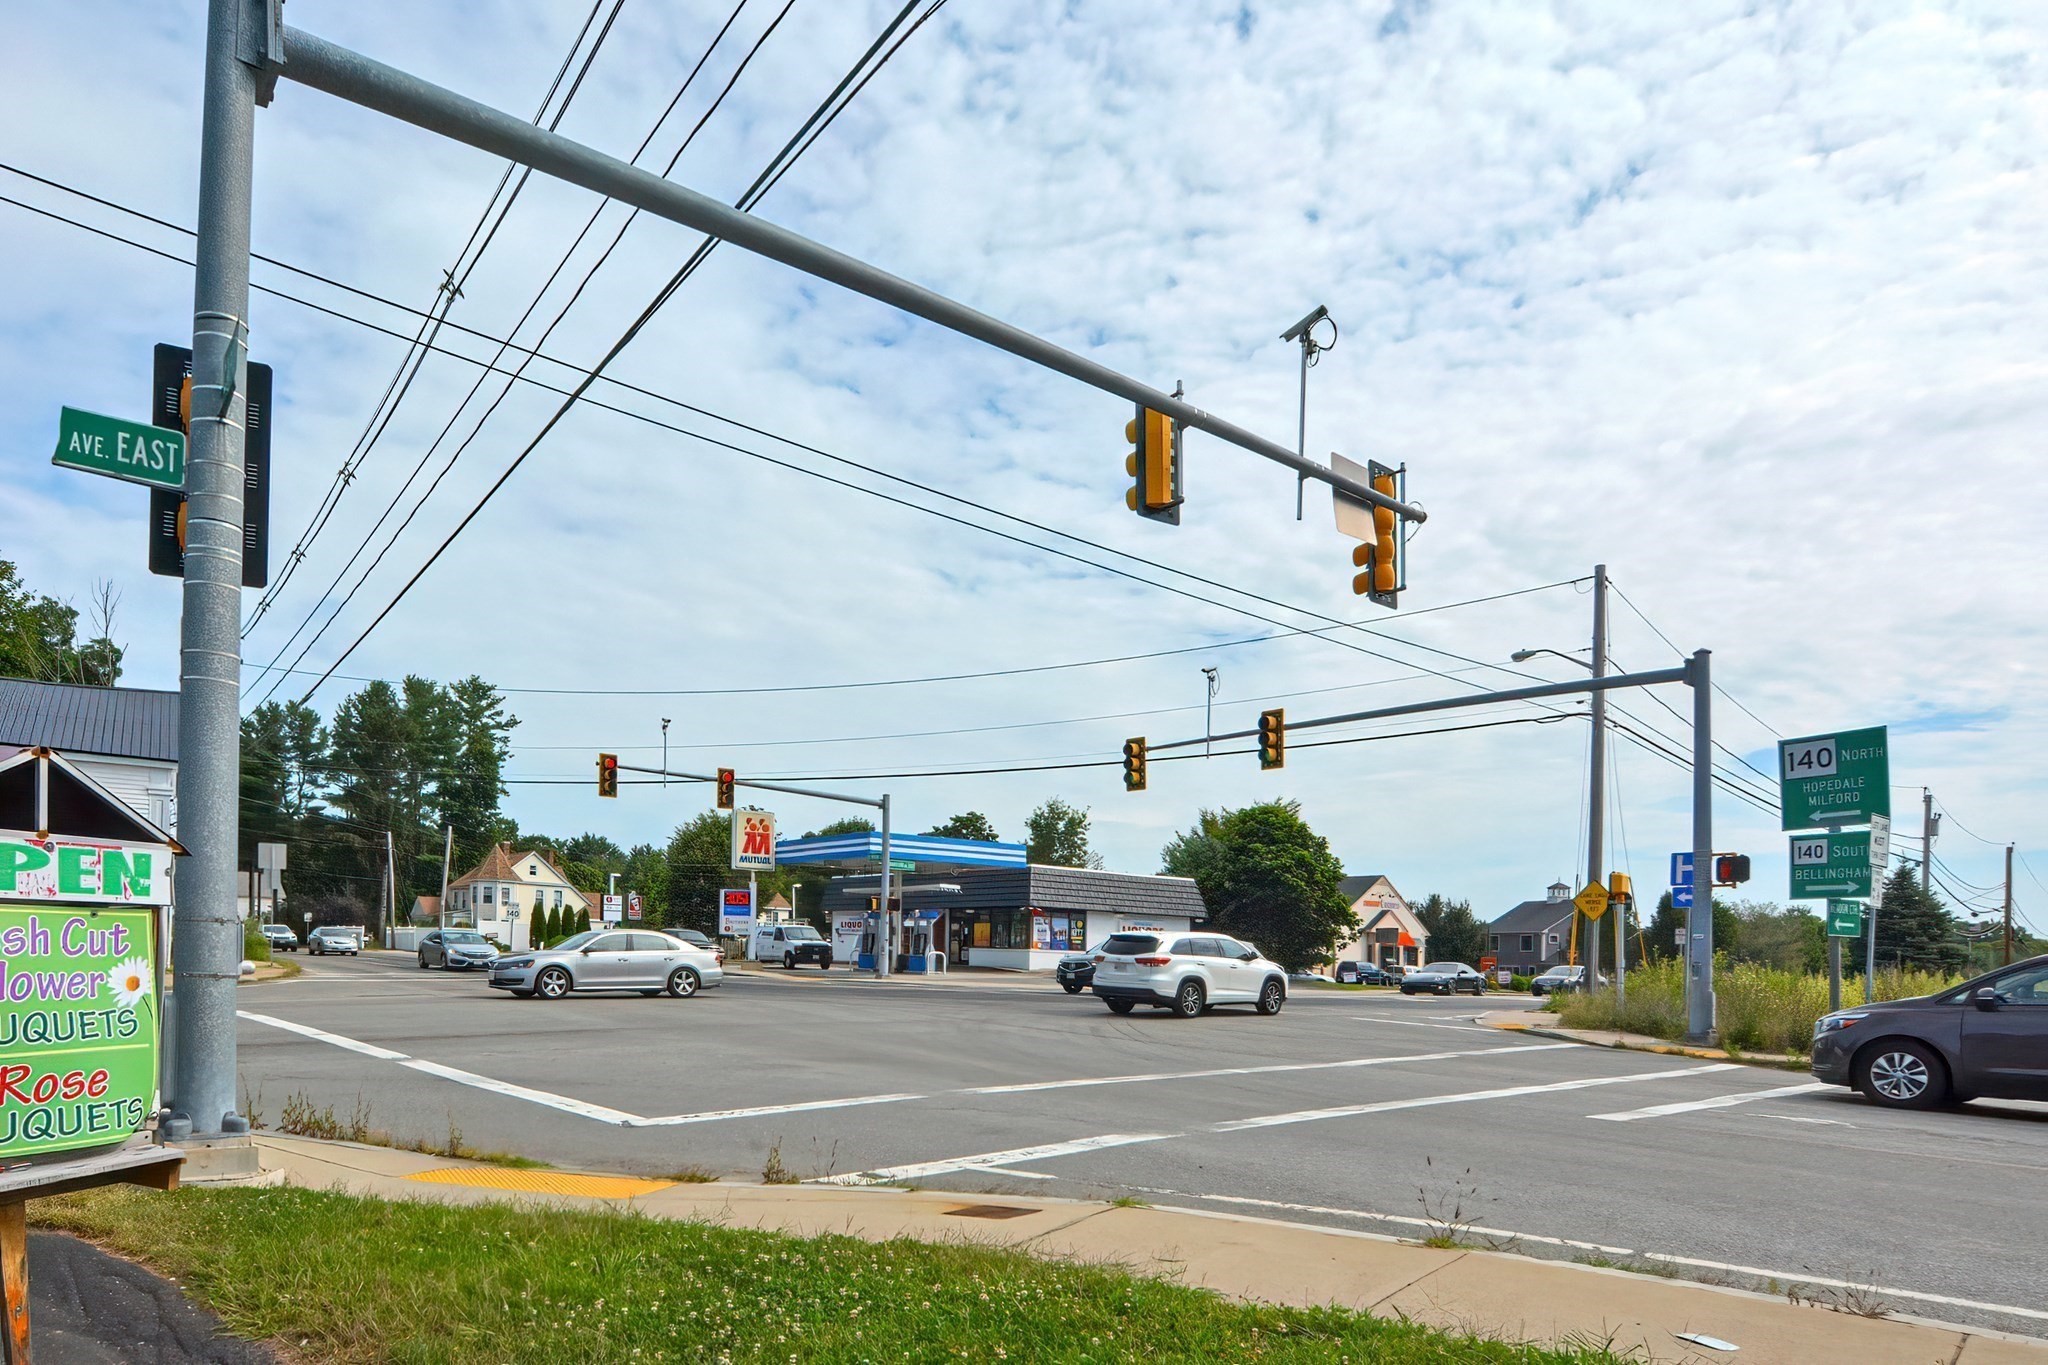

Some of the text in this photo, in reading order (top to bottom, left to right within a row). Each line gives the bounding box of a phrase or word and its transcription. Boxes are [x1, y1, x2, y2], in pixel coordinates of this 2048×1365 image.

[69, 431, 179, 473] AVE. EAST
[1787, 747, 1884, 772] 140 NORTH
[1803, 776, 1865, 793] HOPEDALE
[1808, 791, 1860, 806] MILFORD
[739, 855, 771, 864] MUTUAL
[1798, 845, 1823, 859] 140
[1795, 867, 1870, 880] BELLINGHAM
[62, 918, 129, 955] Cut
[0, 1065, 108, 1106] Rose
